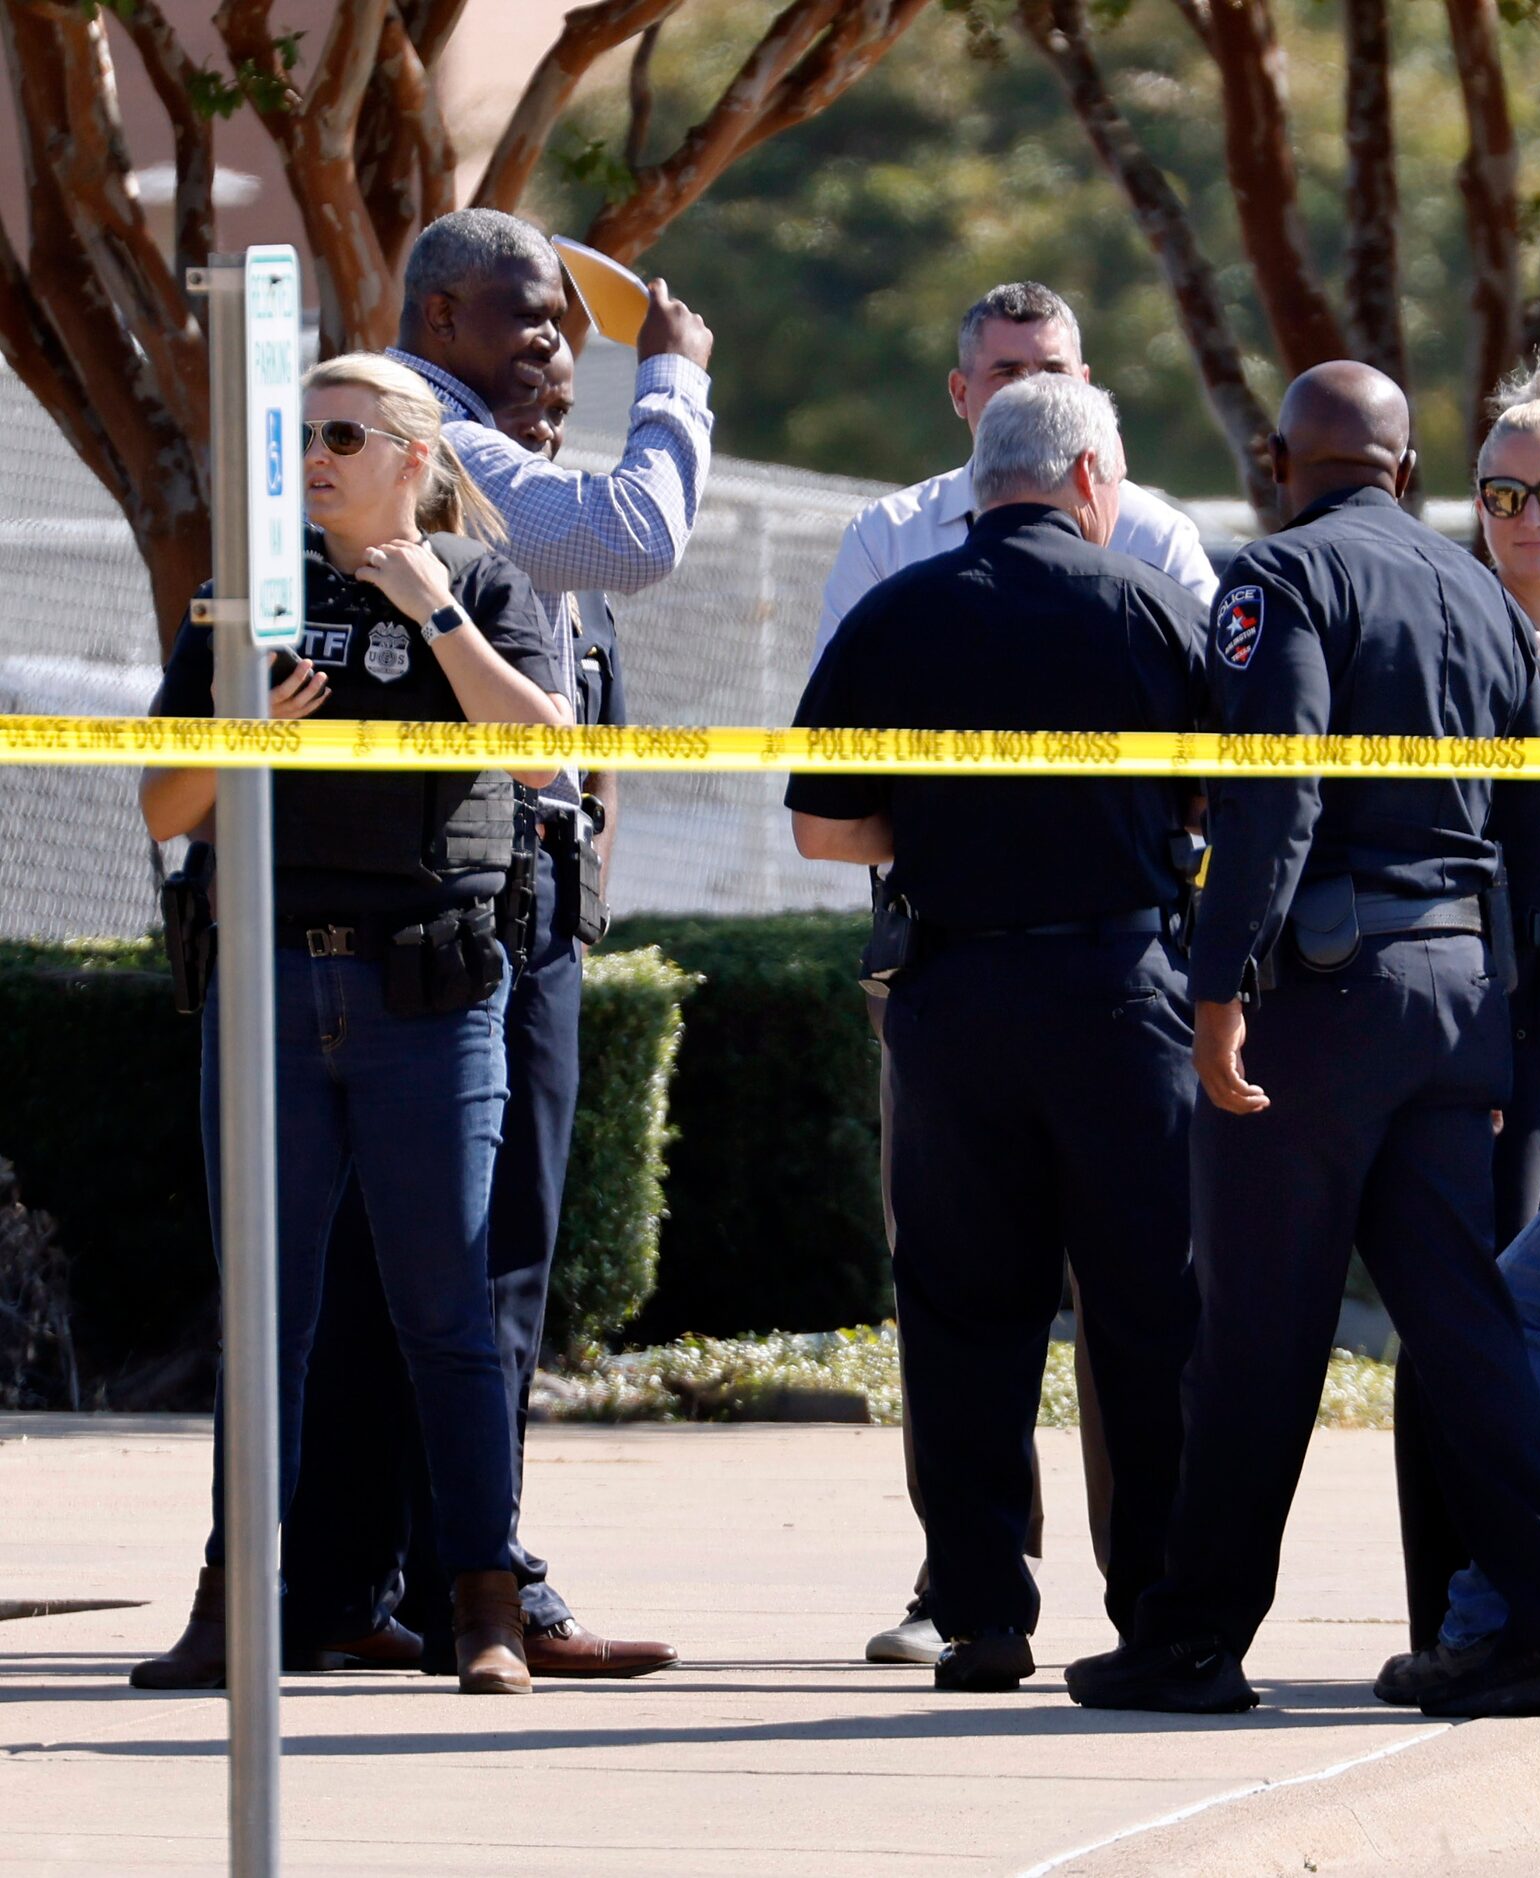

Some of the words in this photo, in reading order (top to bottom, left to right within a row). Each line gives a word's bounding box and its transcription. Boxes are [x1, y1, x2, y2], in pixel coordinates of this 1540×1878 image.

[1217, 589, 1257, 627] POLICE
[75, 718, 125, 749] LINE
[132, 719, 163, 750] DO
[173, 719, 217, 750] NOT
[222, 720, 301, 752] CROSS
[400, 721, 475, 755] POLICE
[484, 723, 534, 756] LINE
[542, 724, 574, 757] DO
[581, 725, 625, 758] NOT
[633, 725, 709, 759] CROSS
[806, 728, 887, 760] POLICE
[894, 729, 945, 761] LINE
[953, 730, 983, 762] DO
[992, 731, 1037, 762] NOT
[1043, 731, 1120, 764] CROSS
[1217, 734, 1295, 766] POLICE
[1303, 735, 1352, 766] LINE
[1360, 735, 1391, 767] DO
[1399, 736, 1440, 767] NOT
[1450, 737, 1526, 769] CROSS
